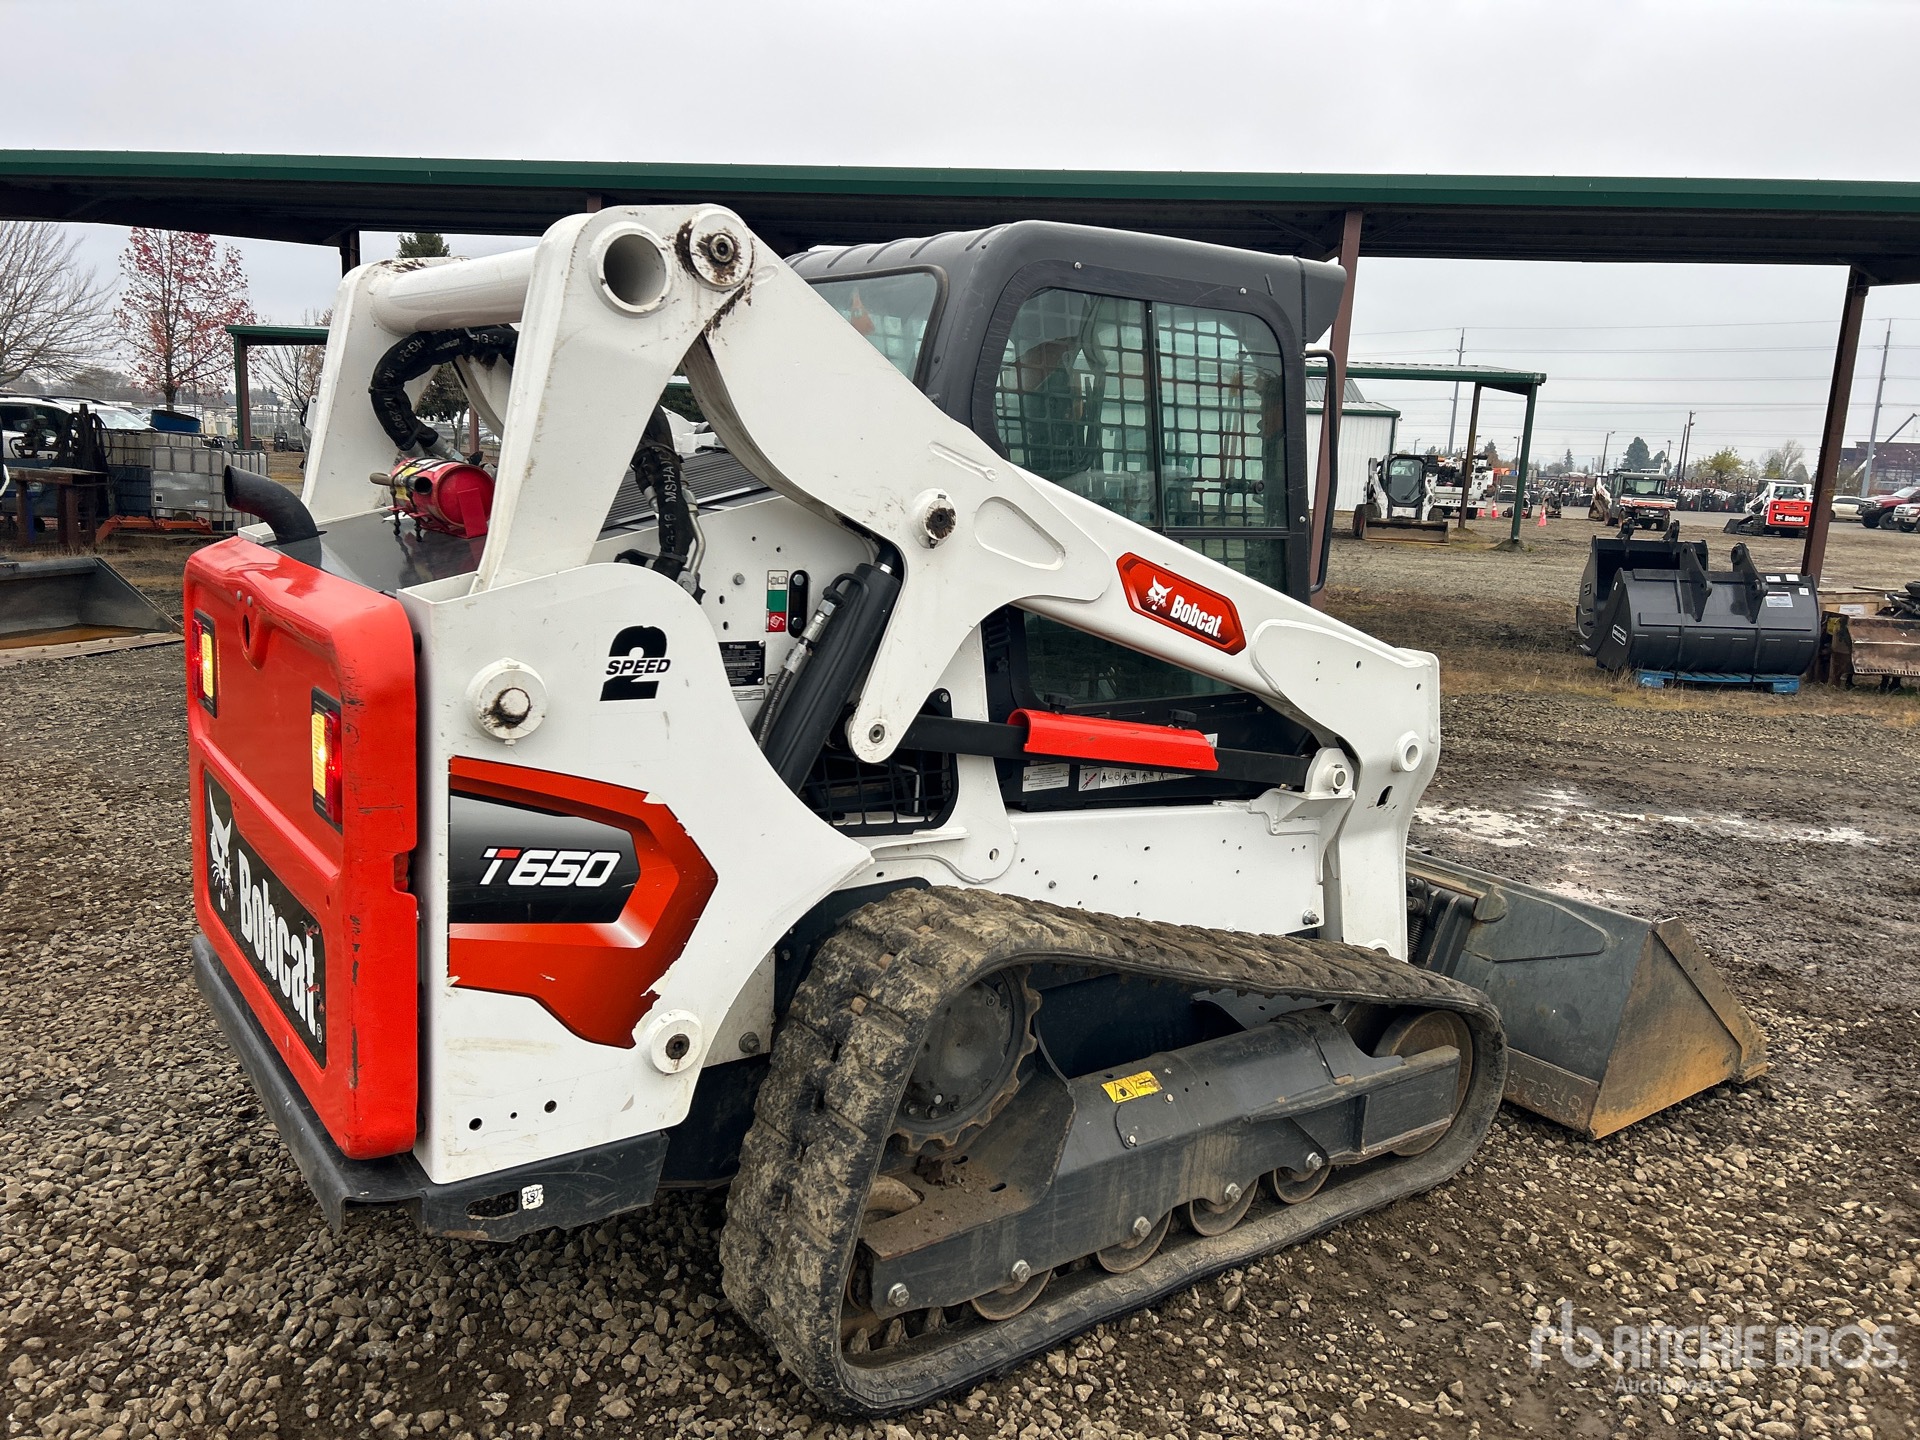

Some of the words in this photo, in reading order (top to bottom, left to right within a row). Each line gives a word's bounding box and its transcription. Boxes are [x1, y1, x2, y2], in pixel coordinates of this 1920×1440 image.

[662, 465, 678, 503] MSHA
[1784, 514, 1804, 523] Bobcat
[1170, 595, 1222, 637] Bobcat
[600, 625, 668, 702] 2
[606, 659, 671, 675] SPEED
[480, 848, 621, 887] T650
[238, 848, 316, 1036] Bobcat
